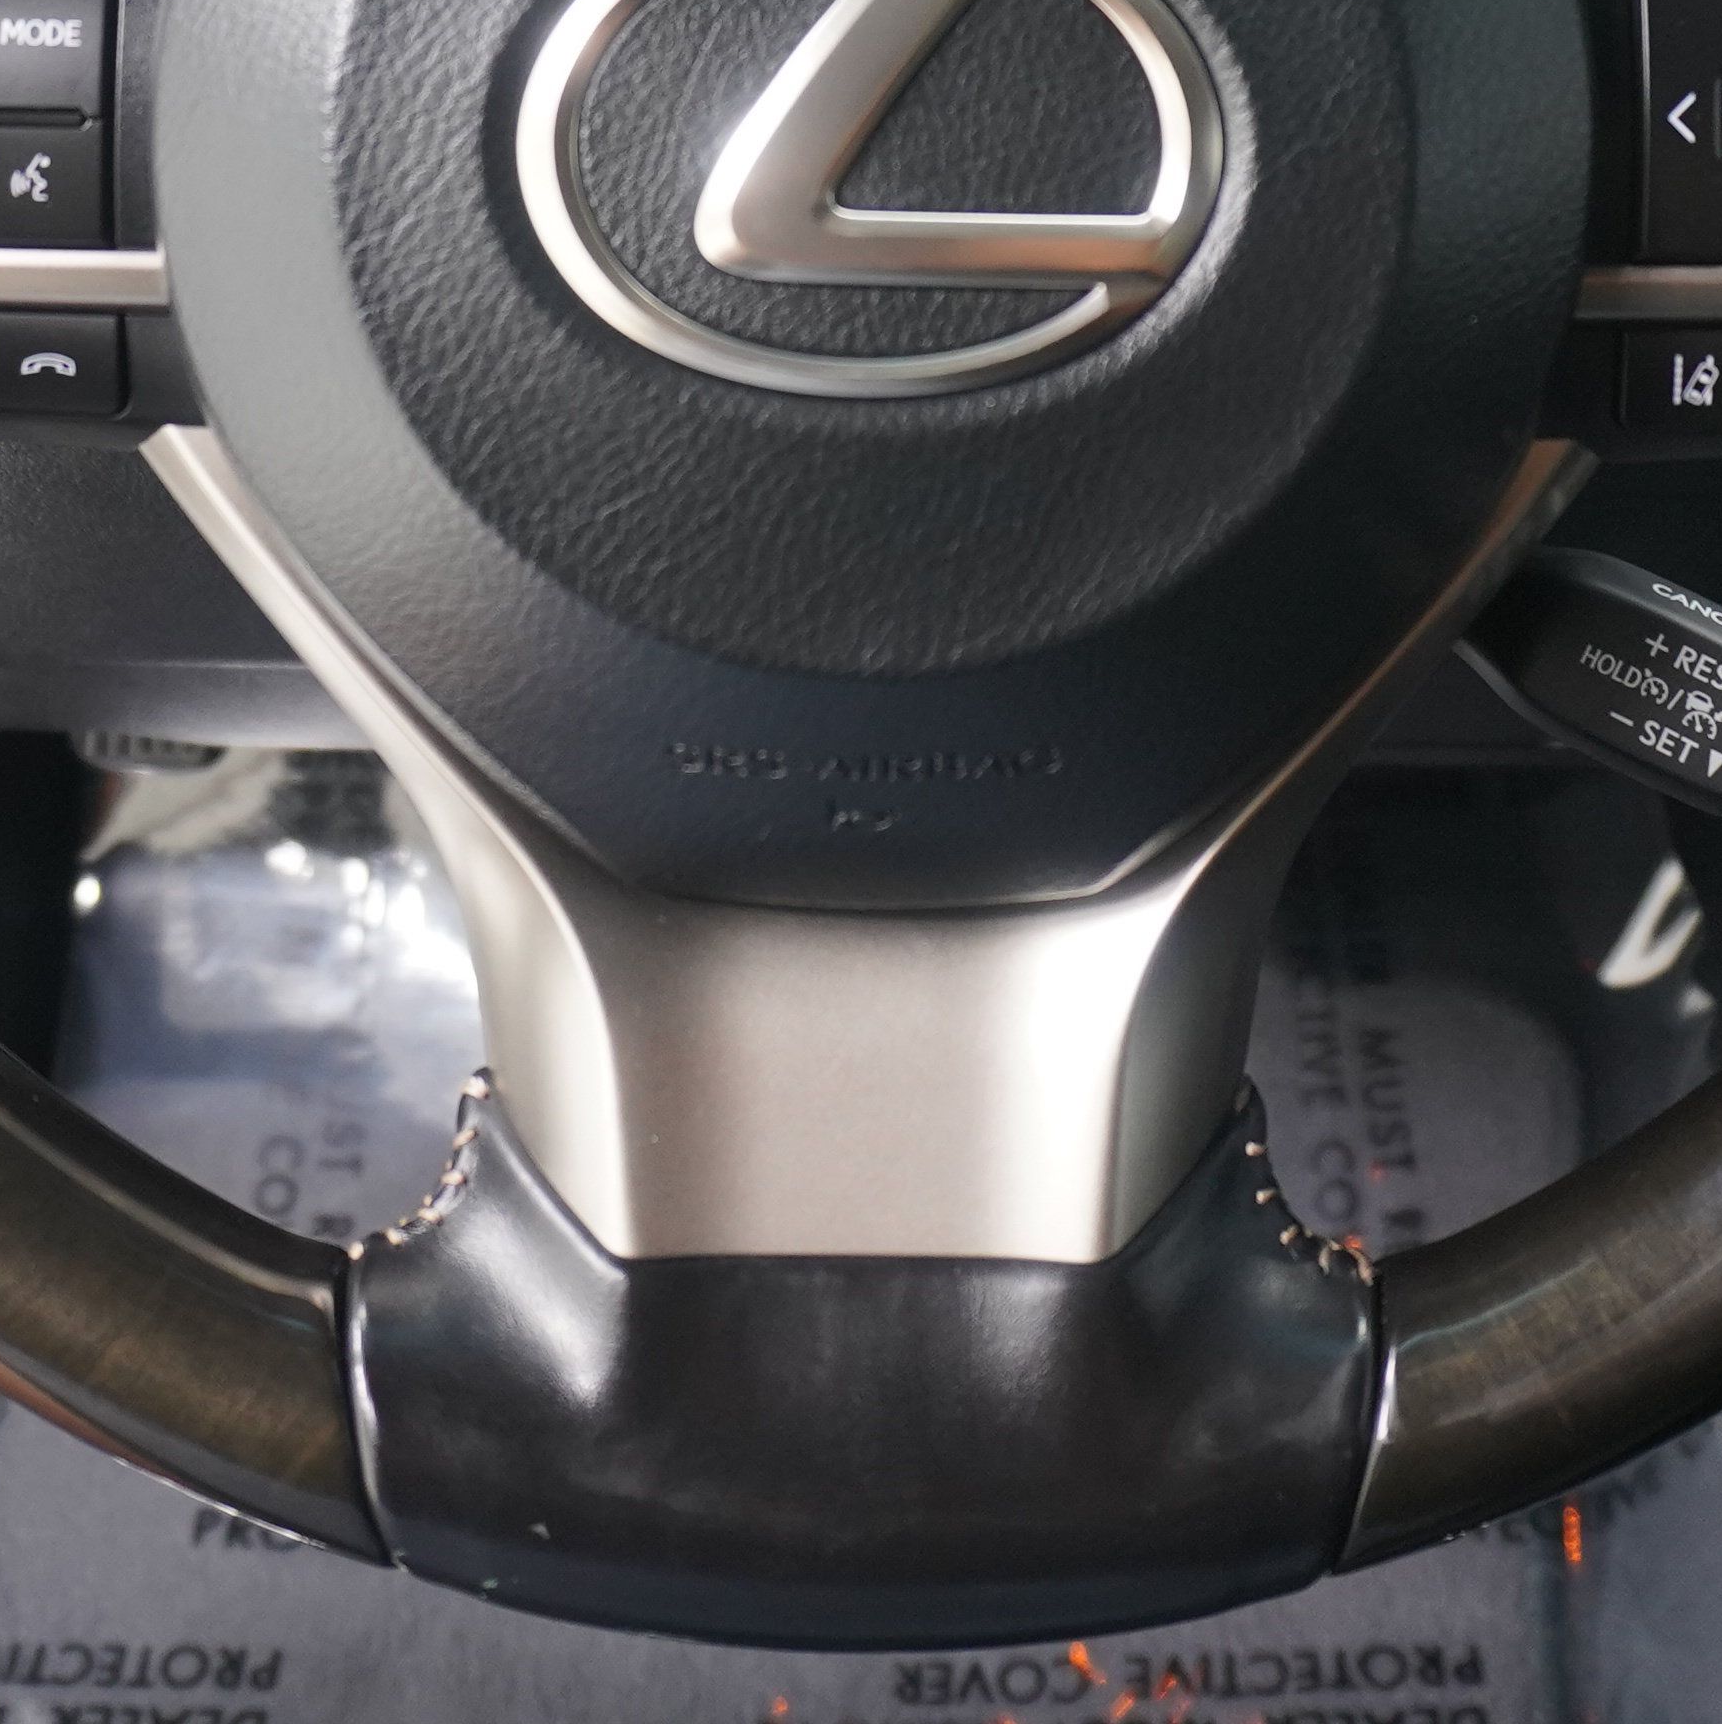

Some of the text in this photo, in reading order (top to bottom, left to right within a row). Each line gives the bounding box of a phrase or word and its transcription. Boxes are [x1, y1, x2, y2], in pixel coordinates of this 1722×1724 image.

[1579, 643, 1644, 690] HOLD
[892, 1644, 1486, 1706] PROTECTIVE COVER
